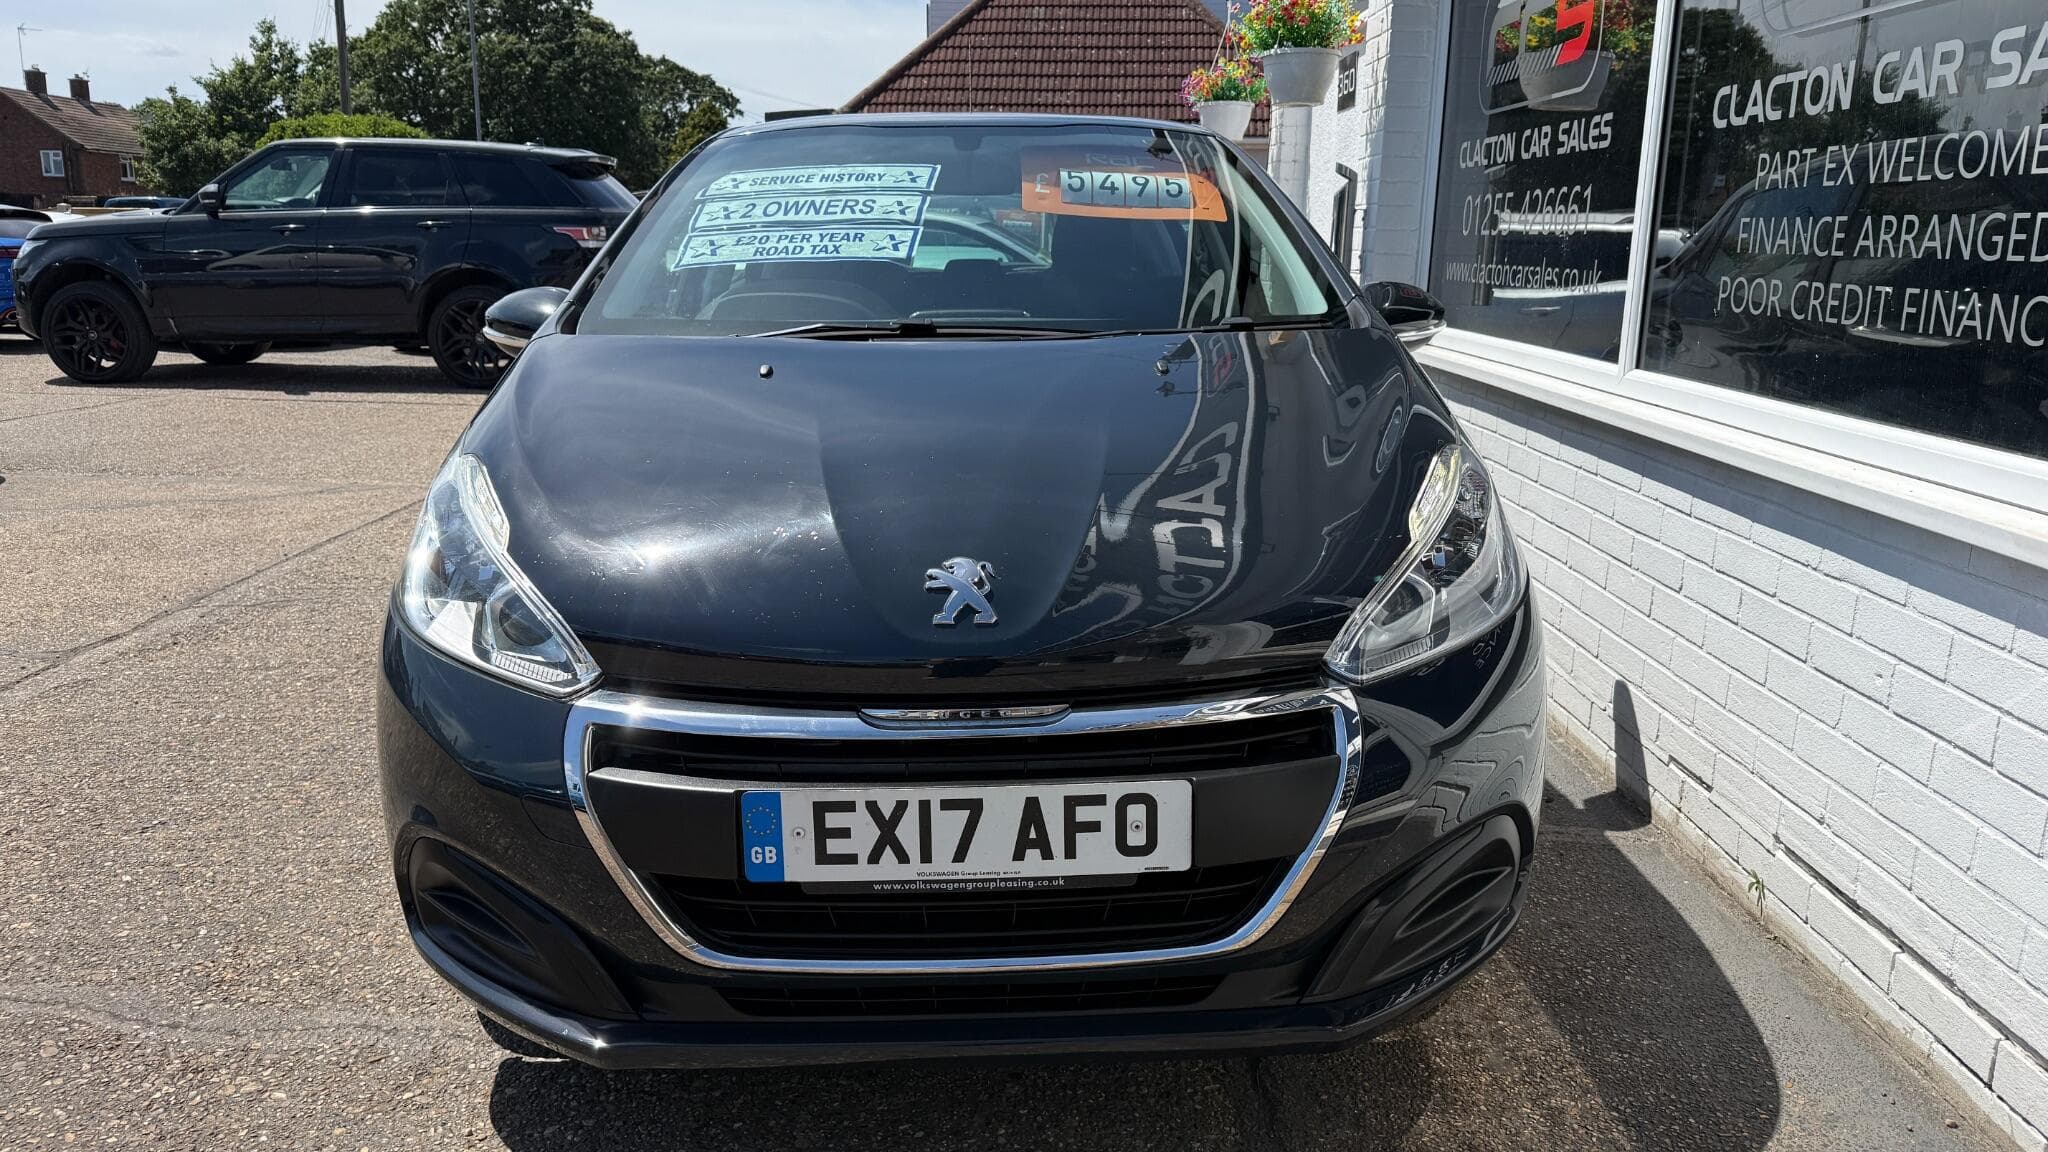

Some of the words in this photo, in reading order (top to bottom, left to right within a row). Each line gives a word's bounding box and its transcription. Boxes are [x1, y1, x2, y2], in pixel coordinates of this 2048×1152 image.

[1712, 60, 1856, 129] CLACTON
[1872, 39, 1965, 104] CAR
[1459, 131, 1516, 169] CLACTON
[1521, 125, 1551, 160] CAR
[1557, 112, 1614, 155] SALES
[1754, 148, 1817, 191] PART
[1823, 143, 1859, 187] EX
[1867, 123, 2048, 184] WELCOME
[749, 174, 815, 187] SERVICE
[819, 172, 887, 184] HISTORY
[1067, 170, 1184, 198] 5495
[739, 203, 757, 219] 2
[762, 199, 877, 218] OWNERS
[1462, 192, 1514, 237] 01255
[1518, 184, 1593, 236] 426661
[734, 234, 771, 247] £20
[774, 233, 813, 245] PER
[818, 232, 866, 243] YEAR
[752, 245, 806, 257] ROAD
[810, 244, 842, 256] TAX
[1736, 215, 1849, 257] FINANCE
[1854, 211, 2048, 263] ARRANGED
[1446, 255, 1603, 296] www.clactoncarsales.co.uk
[1717, 276, 1783, 318] POOR
[1790, 280, 1893, 329] CREDIT
[811, 797, 985, 866] EX17
[1011, 792, 1159, 862] AFO
[750, 845, 778, 865] GB
[873, 876, 1066, 891] www.volkswagengroupleasing.co.uk
